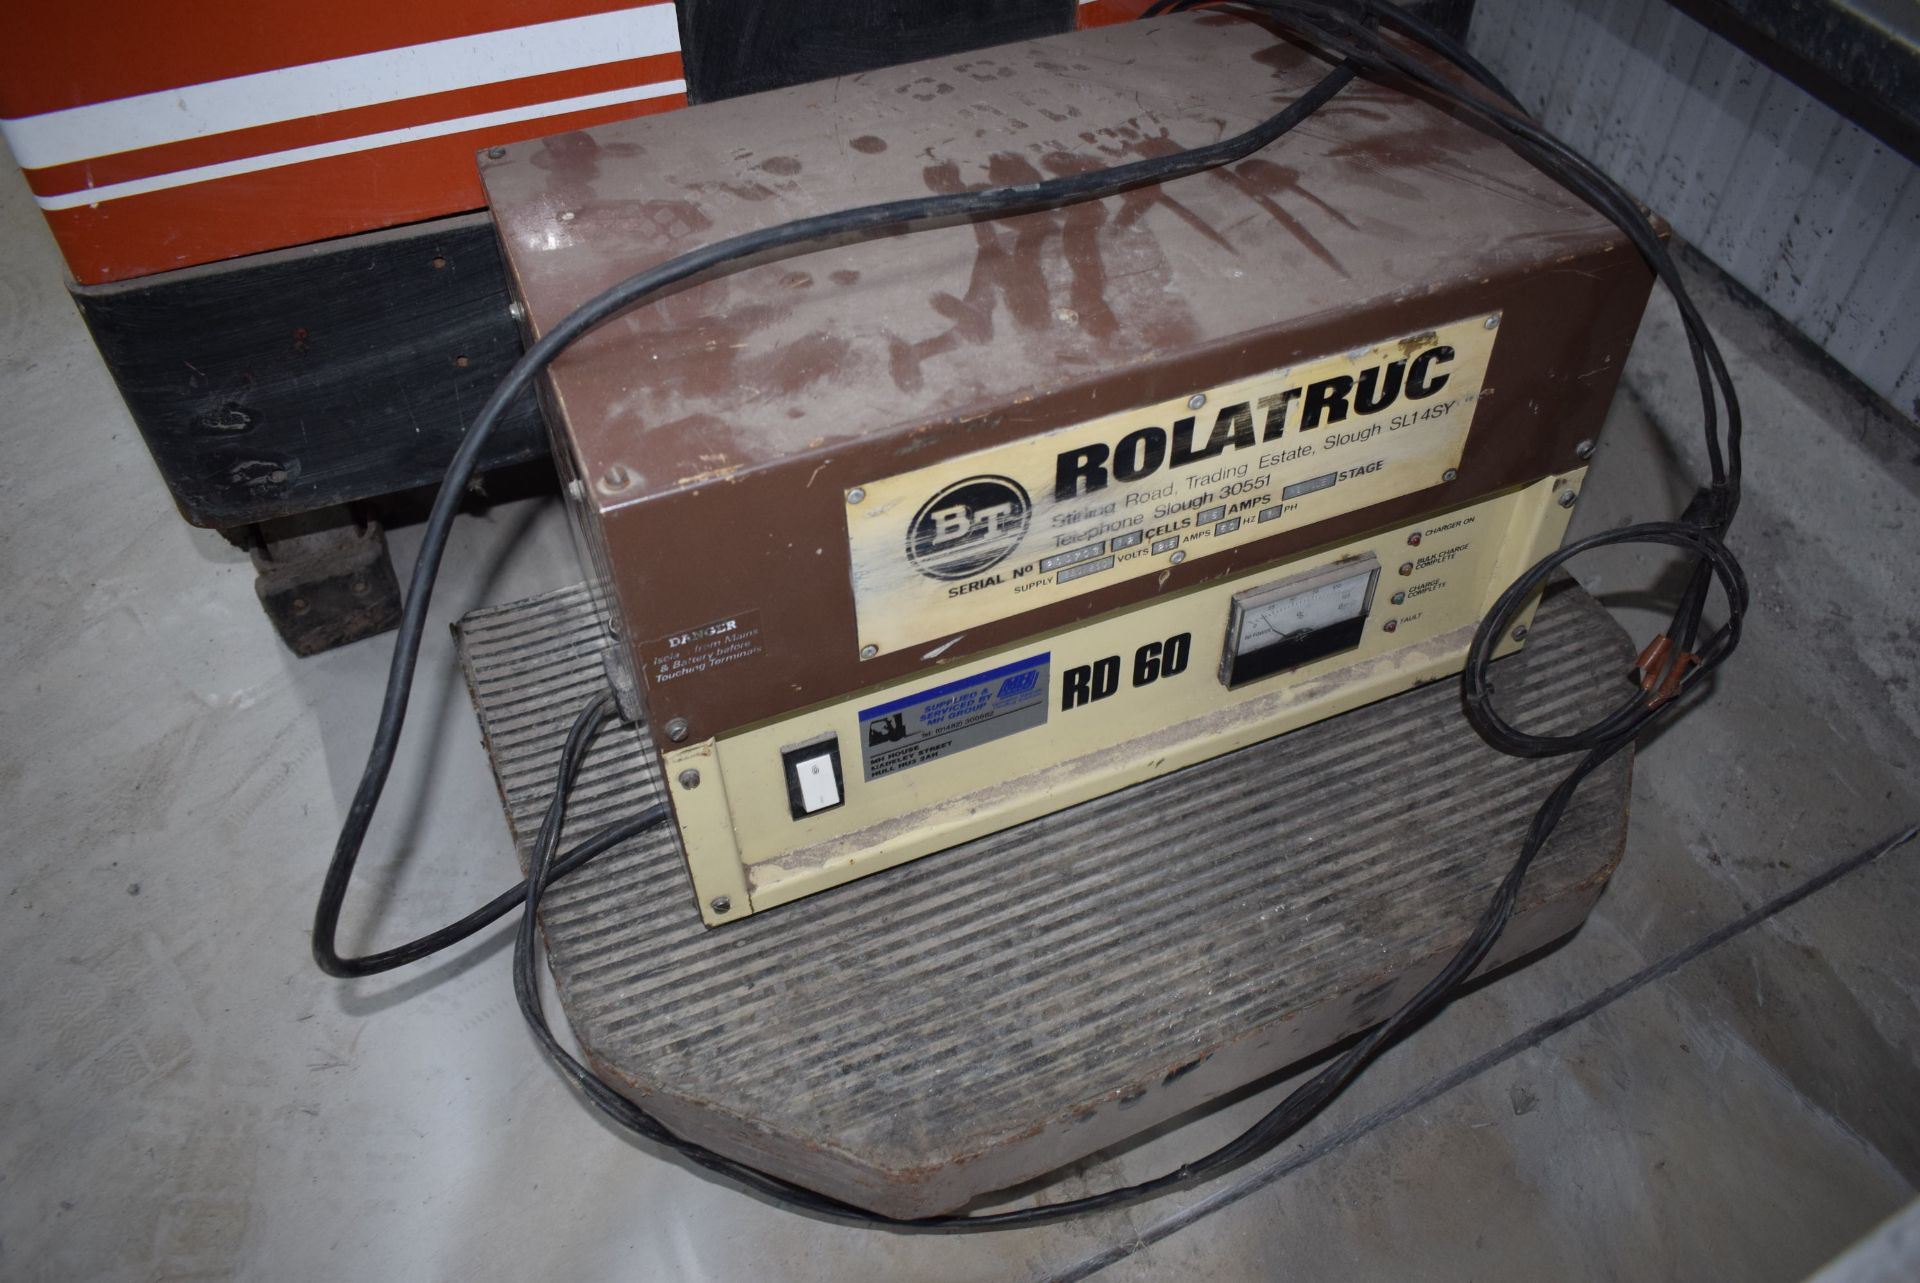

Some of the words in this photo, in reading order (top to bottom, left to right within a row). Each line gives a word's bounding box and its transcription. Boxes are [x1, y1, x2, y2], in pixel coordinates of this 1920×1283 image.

[1055, 346, 1455, 502] ROLATRUC
[1126, 483, 1178, 508] Road,
[1186, 463, 1248, 490] Trading
[1259, 444, 1316, 469] Estate,
[1324, 420, 1381, 450] Slough
[1053, 514, 1144, 547] Telephone
[1154, 493, 1213, 519] Slough
[1219, 474, 1271, 500] 30551
[1145, 518, 1191, 539] CELLS
[1228, 494, 1271, 515] AMPS
[1339, 460, 1384, 482] STAGE
[930, 501, 1013, 546] BT
[1117, 548, 1149, 563] VOLTS
[1183, 530, 1211, 543] AMPS
[1243, 515, 1256, 525] HZ
[1284, 503, 1298, 514] PH
[1425, 521, 1461, 536] CHARGER
[1463, 516, 1475, 525] ON
[1415, 554, 1456, 570] COMPLETE
[1417, 551, 1437, 564] BULK
[1438, 543, 1470, 558] CHARGE
[948, 574, 1005, 598] SERIAL
[1014, 577, 1054, 594] SUPPLY
[1407, 582, 1446, 599] COMPLETE
[1408, 578, 1440, 593] CHARGE
[668, 619, 737, 648] DANGER
[724, 628, 759, 646] Mains
[655, 662, 706, 684] Touching
[710, 645, 762, 667] Terminals
[659, 664, 669, 674] &
[672, 652, 714, 671] Battery
[716, 641, 751, 656] before
[1062, 655, 1121, 711] RD
[1133, 632, 1191, 688] 60
[920, 700, 975, 721] SERVICED
[979, 694, 993, 704] BY
[925, 691, 977, 712] SUPPLIED
[979, 688, 989, 696] &
[948, 703, 987, 720] GROUP
[888, 745, 920, 759] HOUSE
[918, 740, 952, 755] STREET
